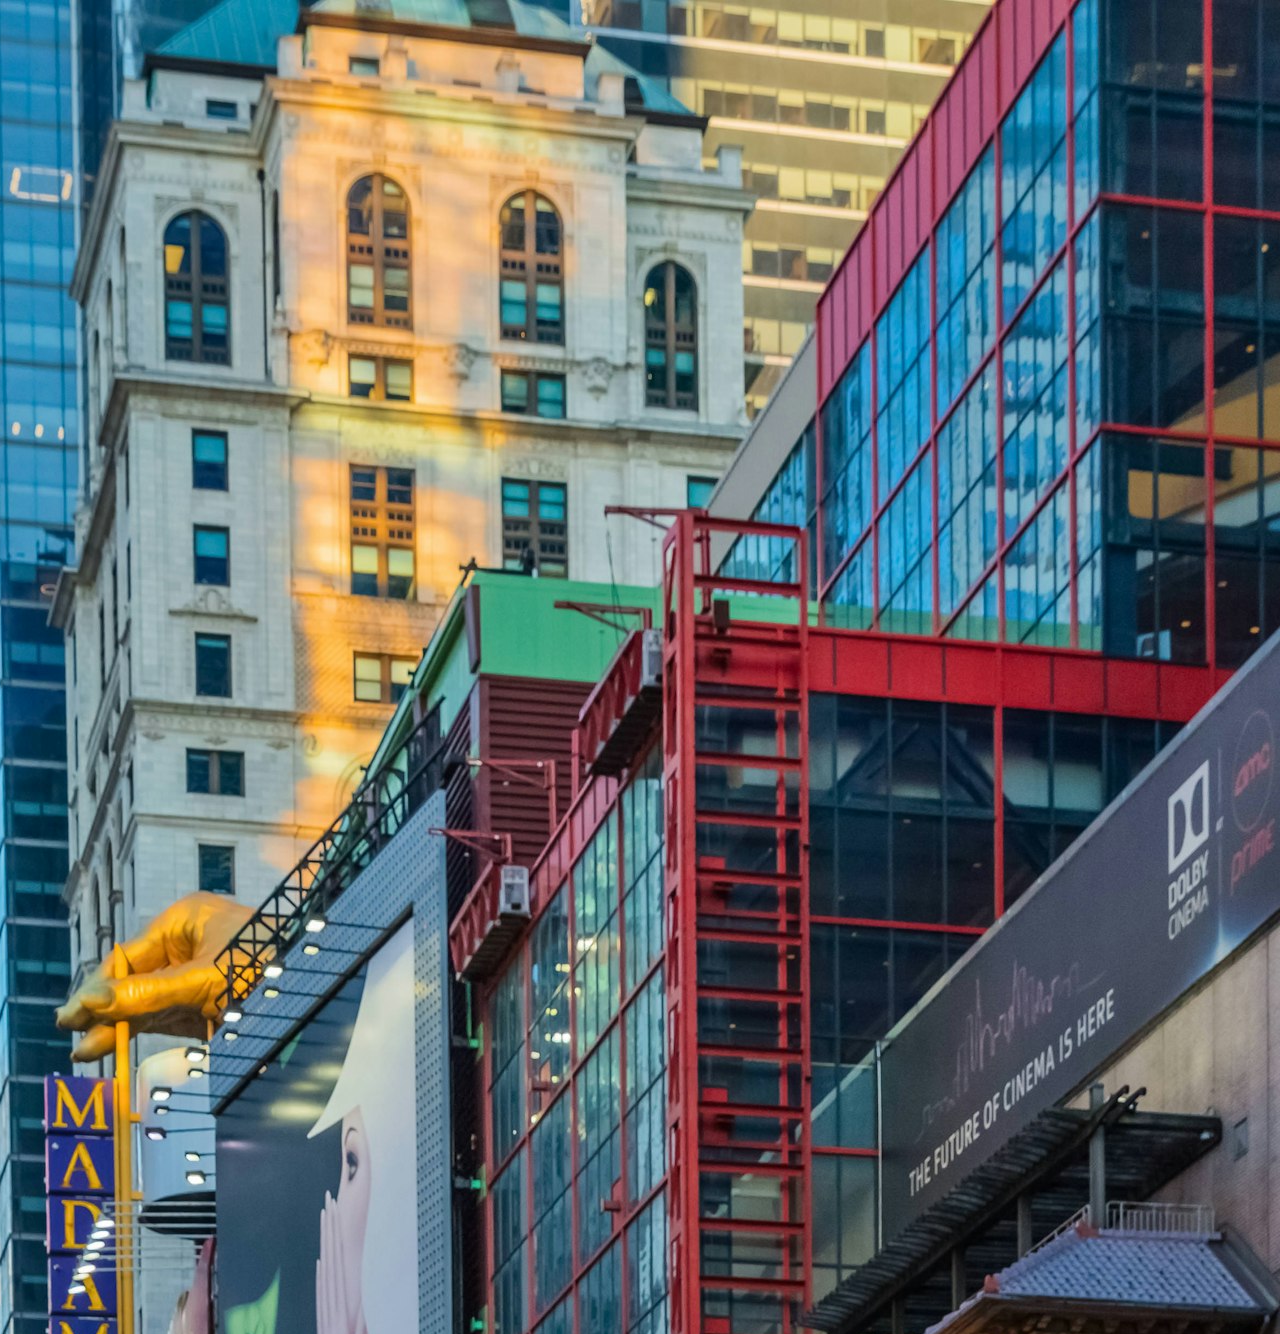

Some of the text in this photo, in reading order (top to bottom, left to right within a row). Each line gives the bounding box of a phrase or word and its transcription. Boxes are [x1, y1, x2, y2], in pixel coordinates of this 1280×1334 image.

[1168, 850, 1209, 910] DOLBY
[1168, 885, 1209, 940] CINEMA
[909, 988, 1116, 1196] THE FUTURE OF CINEMA IS HERE
